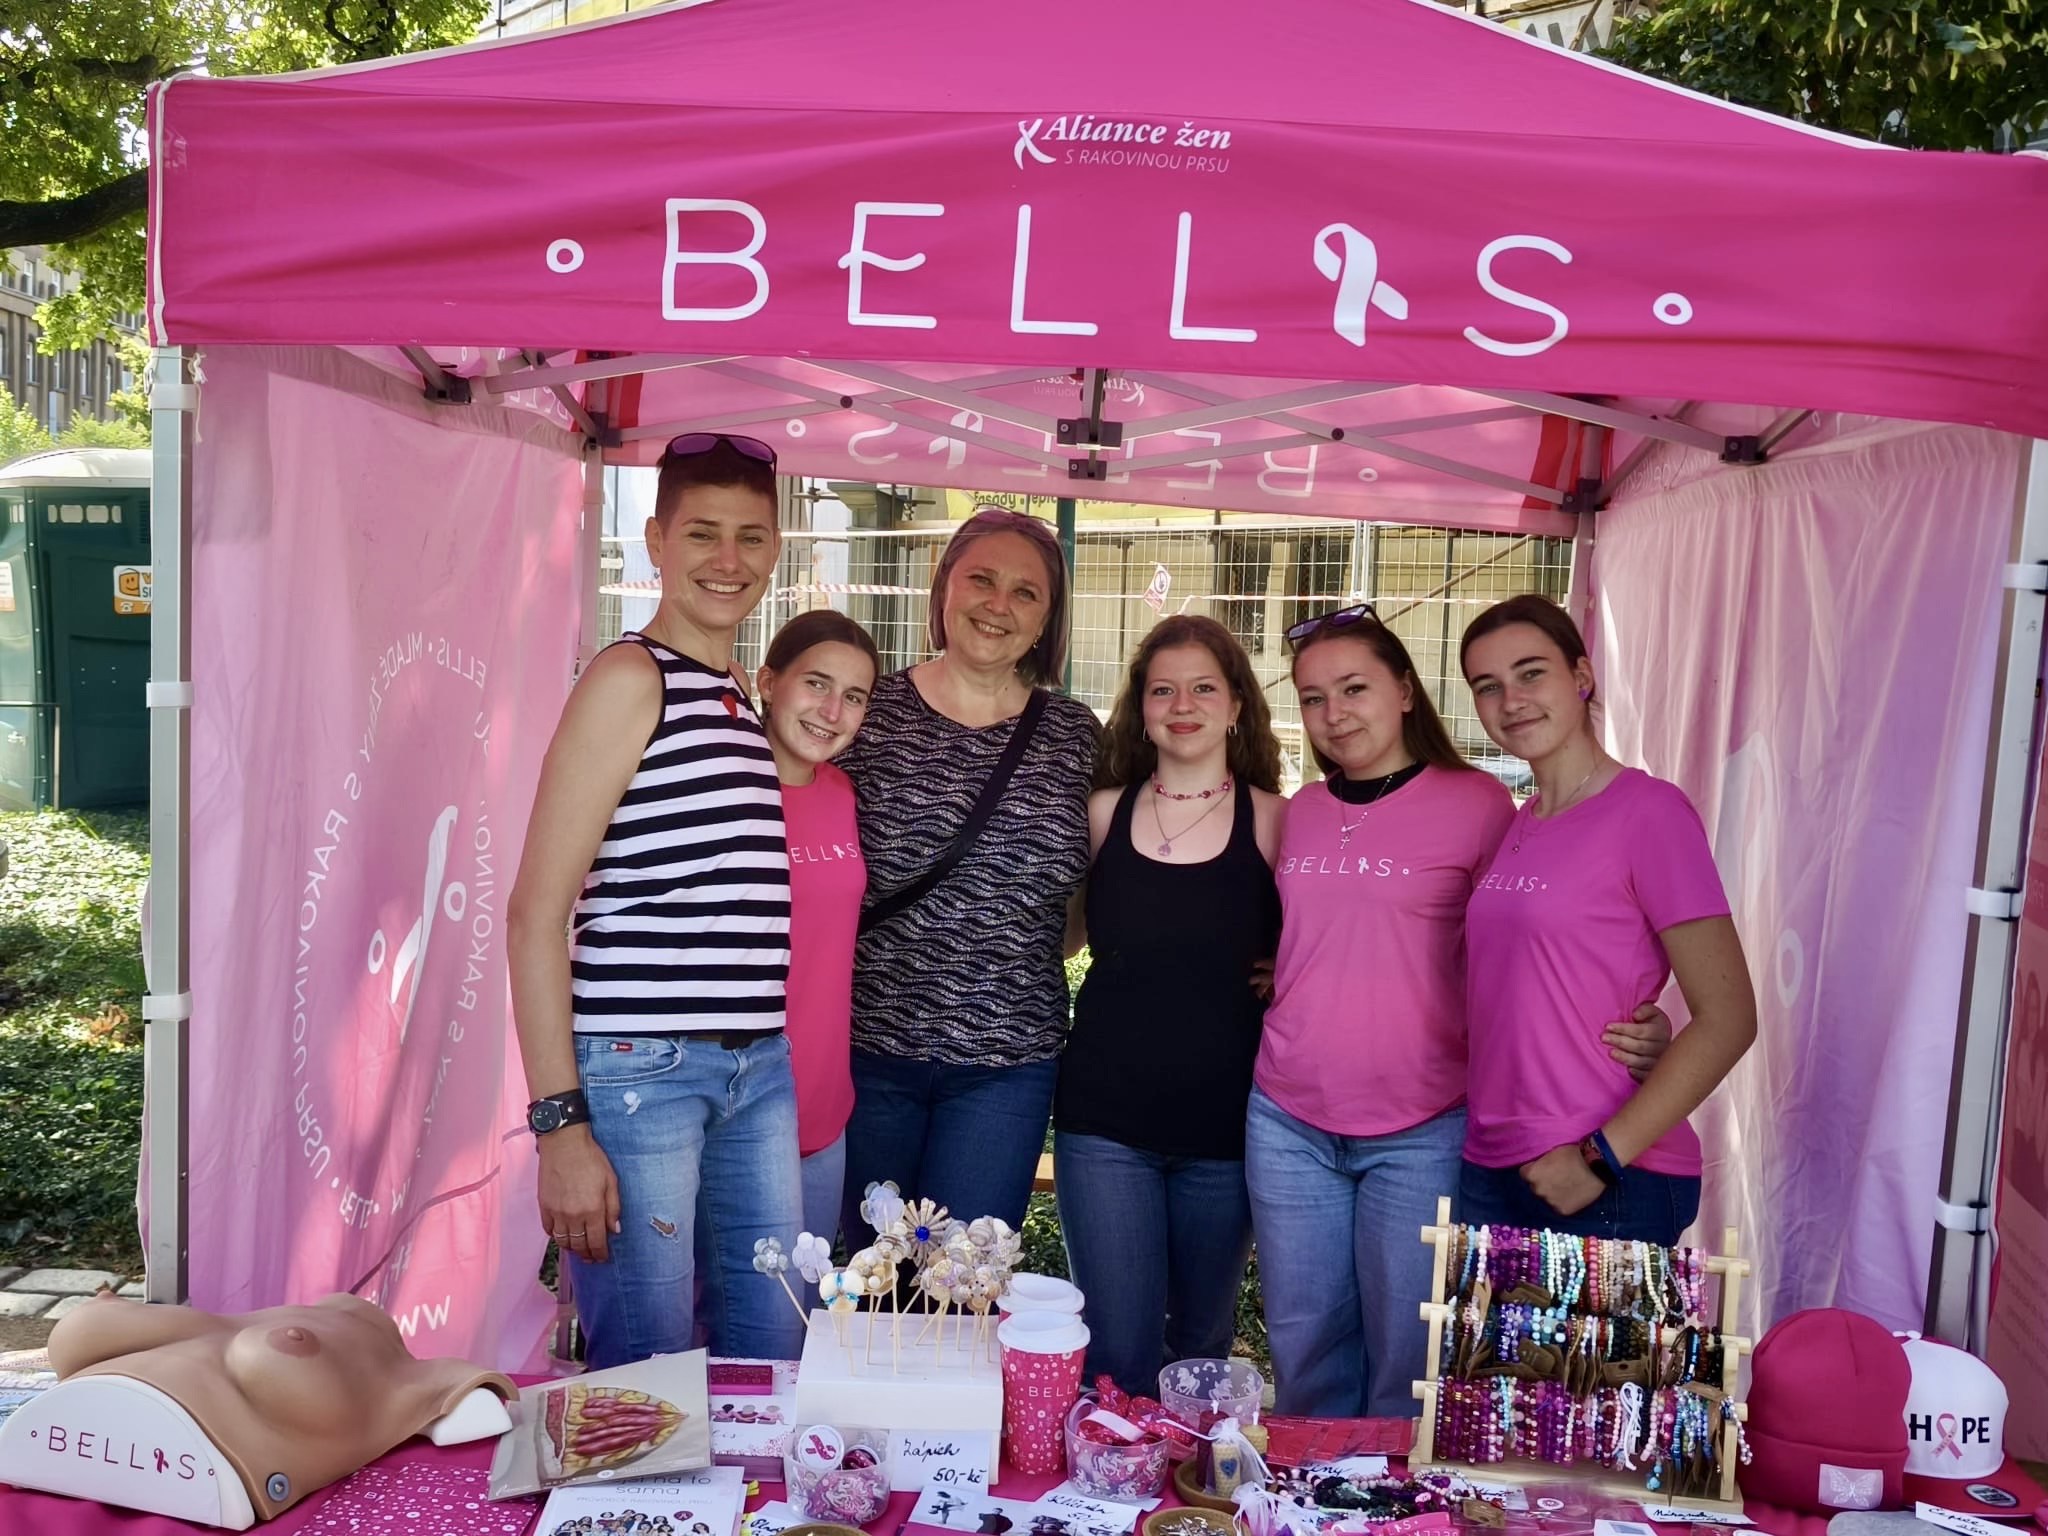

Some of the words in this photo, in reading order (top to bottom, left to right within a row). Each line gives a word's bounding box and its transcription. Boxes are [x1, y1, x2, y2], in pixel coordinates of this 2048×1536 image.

[1041, 115, 1167, 144] Aliance
[1174, 121, 1232, 149] žen
[1065, 150, 1075, 165] S
[1079, 150, 1181, 169] RAKOVINOU
[1185, 157, 1230, 173] PRSU
[790, 842, 858, 863] ELLIS
[1028, 1384, 1073, 1398] BELL
[1908, 1413, 1990, 1452] HOPE
[616, 1486, 680, 1495] sama
